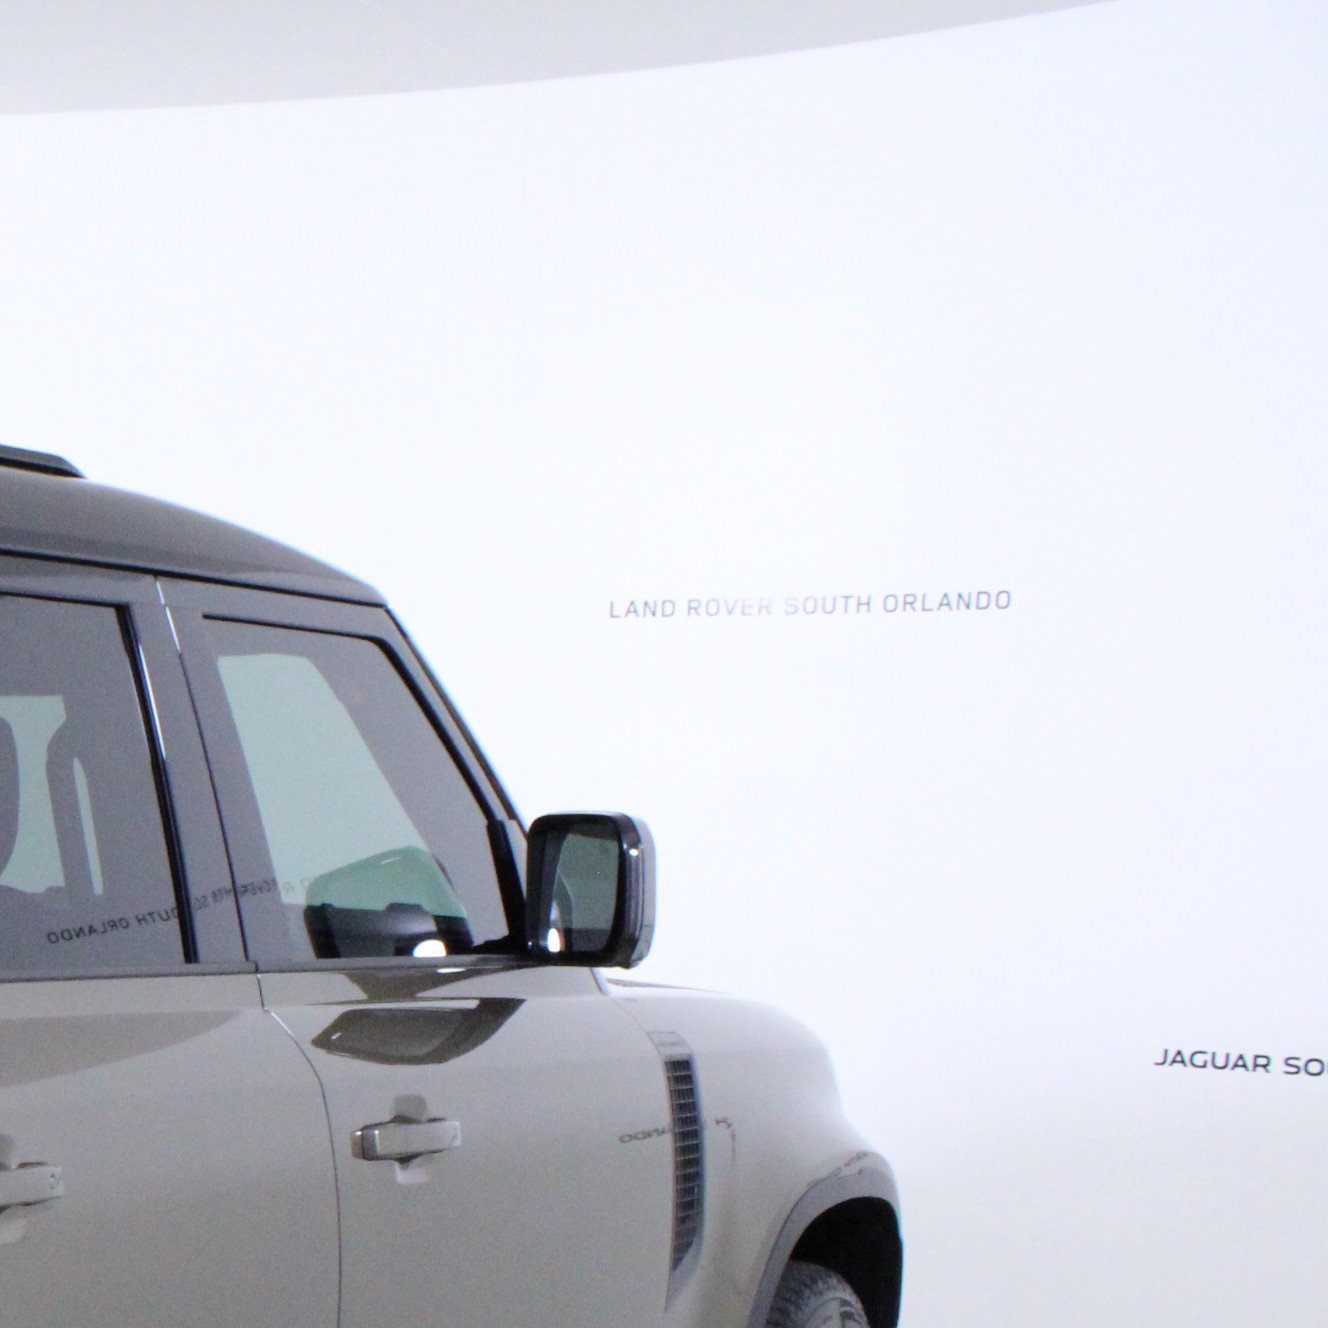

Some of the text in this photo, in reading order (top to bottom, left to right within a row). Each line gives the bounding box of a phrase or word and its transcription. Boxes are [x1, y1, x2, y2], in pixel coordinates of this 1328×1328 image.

[609, 589, 1012, 618] LAND ROVER SOUTH ORLANDO
[1153, 1048, 1328, 1077] JAGUAR SO
